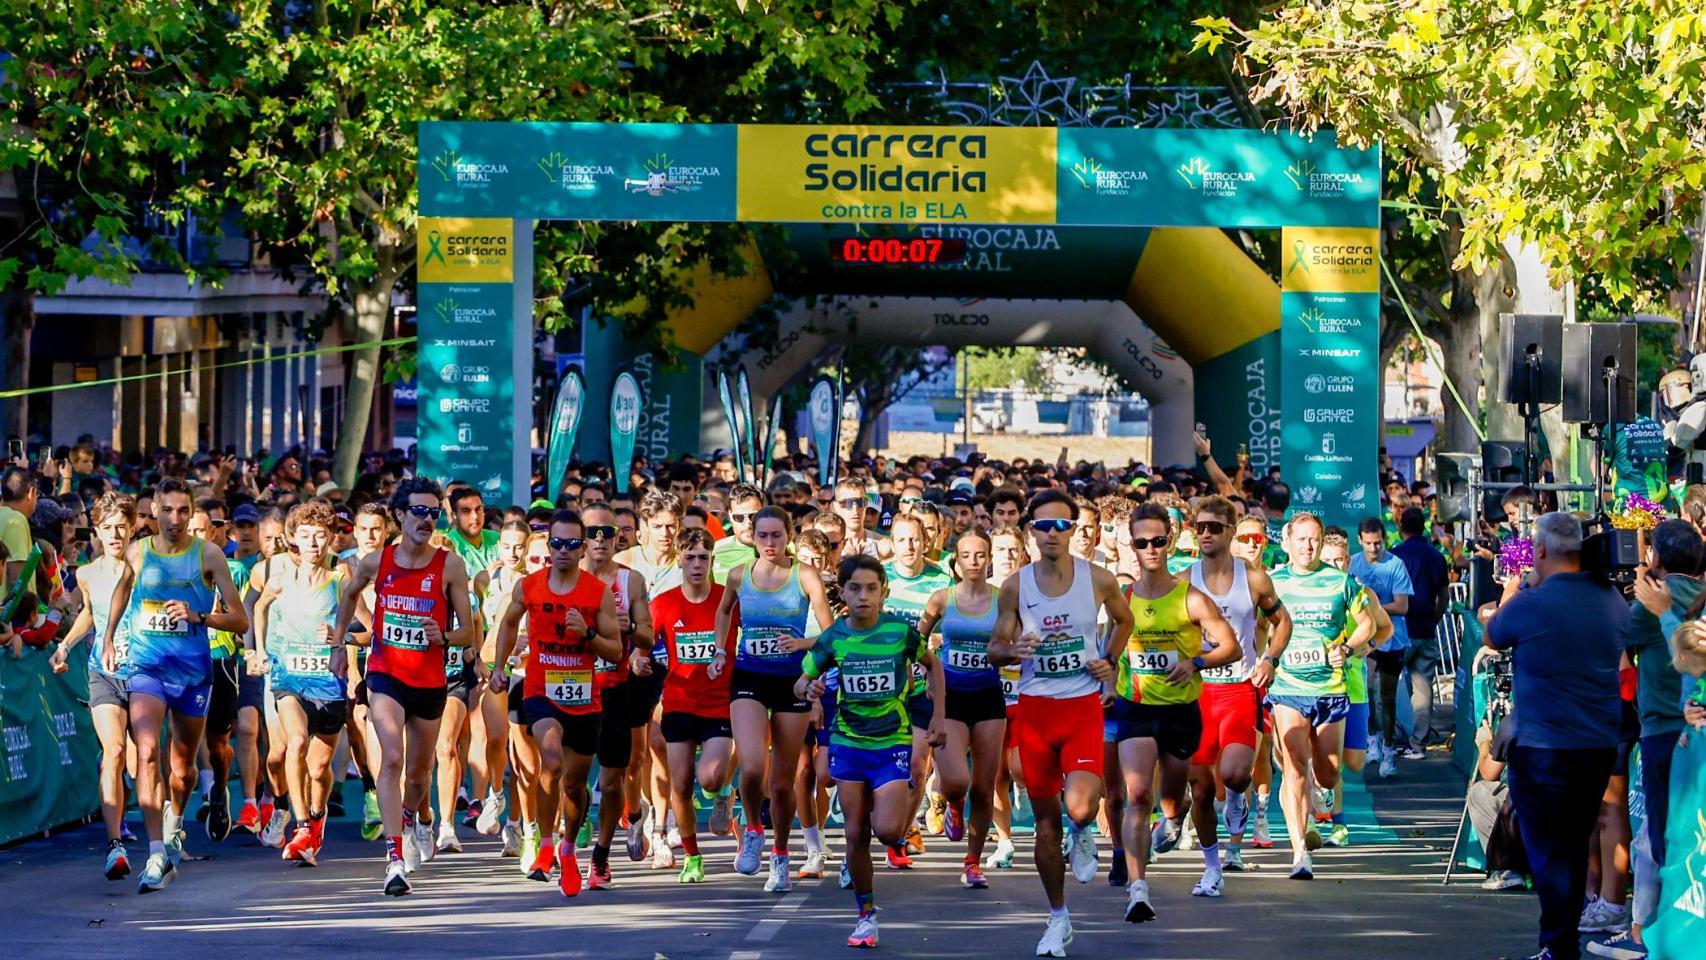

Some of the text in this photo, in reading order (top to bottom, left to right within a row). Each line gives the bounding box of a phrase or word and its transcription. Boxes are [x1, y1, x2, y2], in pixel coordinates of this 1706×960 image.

[804, 133, 986, 159] carrera
[456, 164, 509, 174] EUROCAJA
[562, 165, 615, 175] EUROCAJA
[668, 166, 720, 176] EUROCAJA
[456, 173, 490, 182] RURAL
[562, 175, 596, 184] RURAL
[804, 163, 986, 193] Solidaria
[1096, 171, 1149, 181] EUROCAJA
[1202, 171, 1256, 181] EUROCAJA
[1309, 173, 1363, 183] EUROCAJA
[1096, 180, 1130, 189] RURAL
[1202, 180, 1237, 190] RURAL
[1309, 182, 1345, 191] RURAL
[821, 202, 968, 219] contra la ELA
[447, 236, 507, 245] carrera
[447, 246, 507, 256] Solidaria
[843, 239, 943, 263] 0:00:07
[1312, 245, 1373, 255] carrera
[1312, 255, 1373, 266] Solidaria
[454, 308, 497, 316] EUROCAJA
[454, 316, 482, 324] RURAL
[1319, 318, 1361, 327] EUROCAJA
[447, 339, 496, 347] MINSAIT
[1312, 349, 1361, 357] MINSAIT
[463, 366, 490, 374] GRUPO
[463, 374, 489, 382] EULEN
[1327, 376, 1354, 384] GRUPO
[1327, 384, 1354, 392] EULEN
[1316, 415, 1354, 423] UNITEL
[650, 394, 671, 463] URAL
[149, 615, 178, 631] 449
[1043, 613, 1070, 626] CAT
[386, 626, 424, 644] 1914
[680, 644, 717, 659] 1379
[1288, 649, 1320, 664] 1990
[293, 657, 328, 671] 1535
[952, 652, 988, 668] 1564
[1038, 653, 1081, 672] 1643
[1137, 653, 1169, 669] 340
[848, 674, 890, 693] 1652
[554, 685, 584, 700] 434
